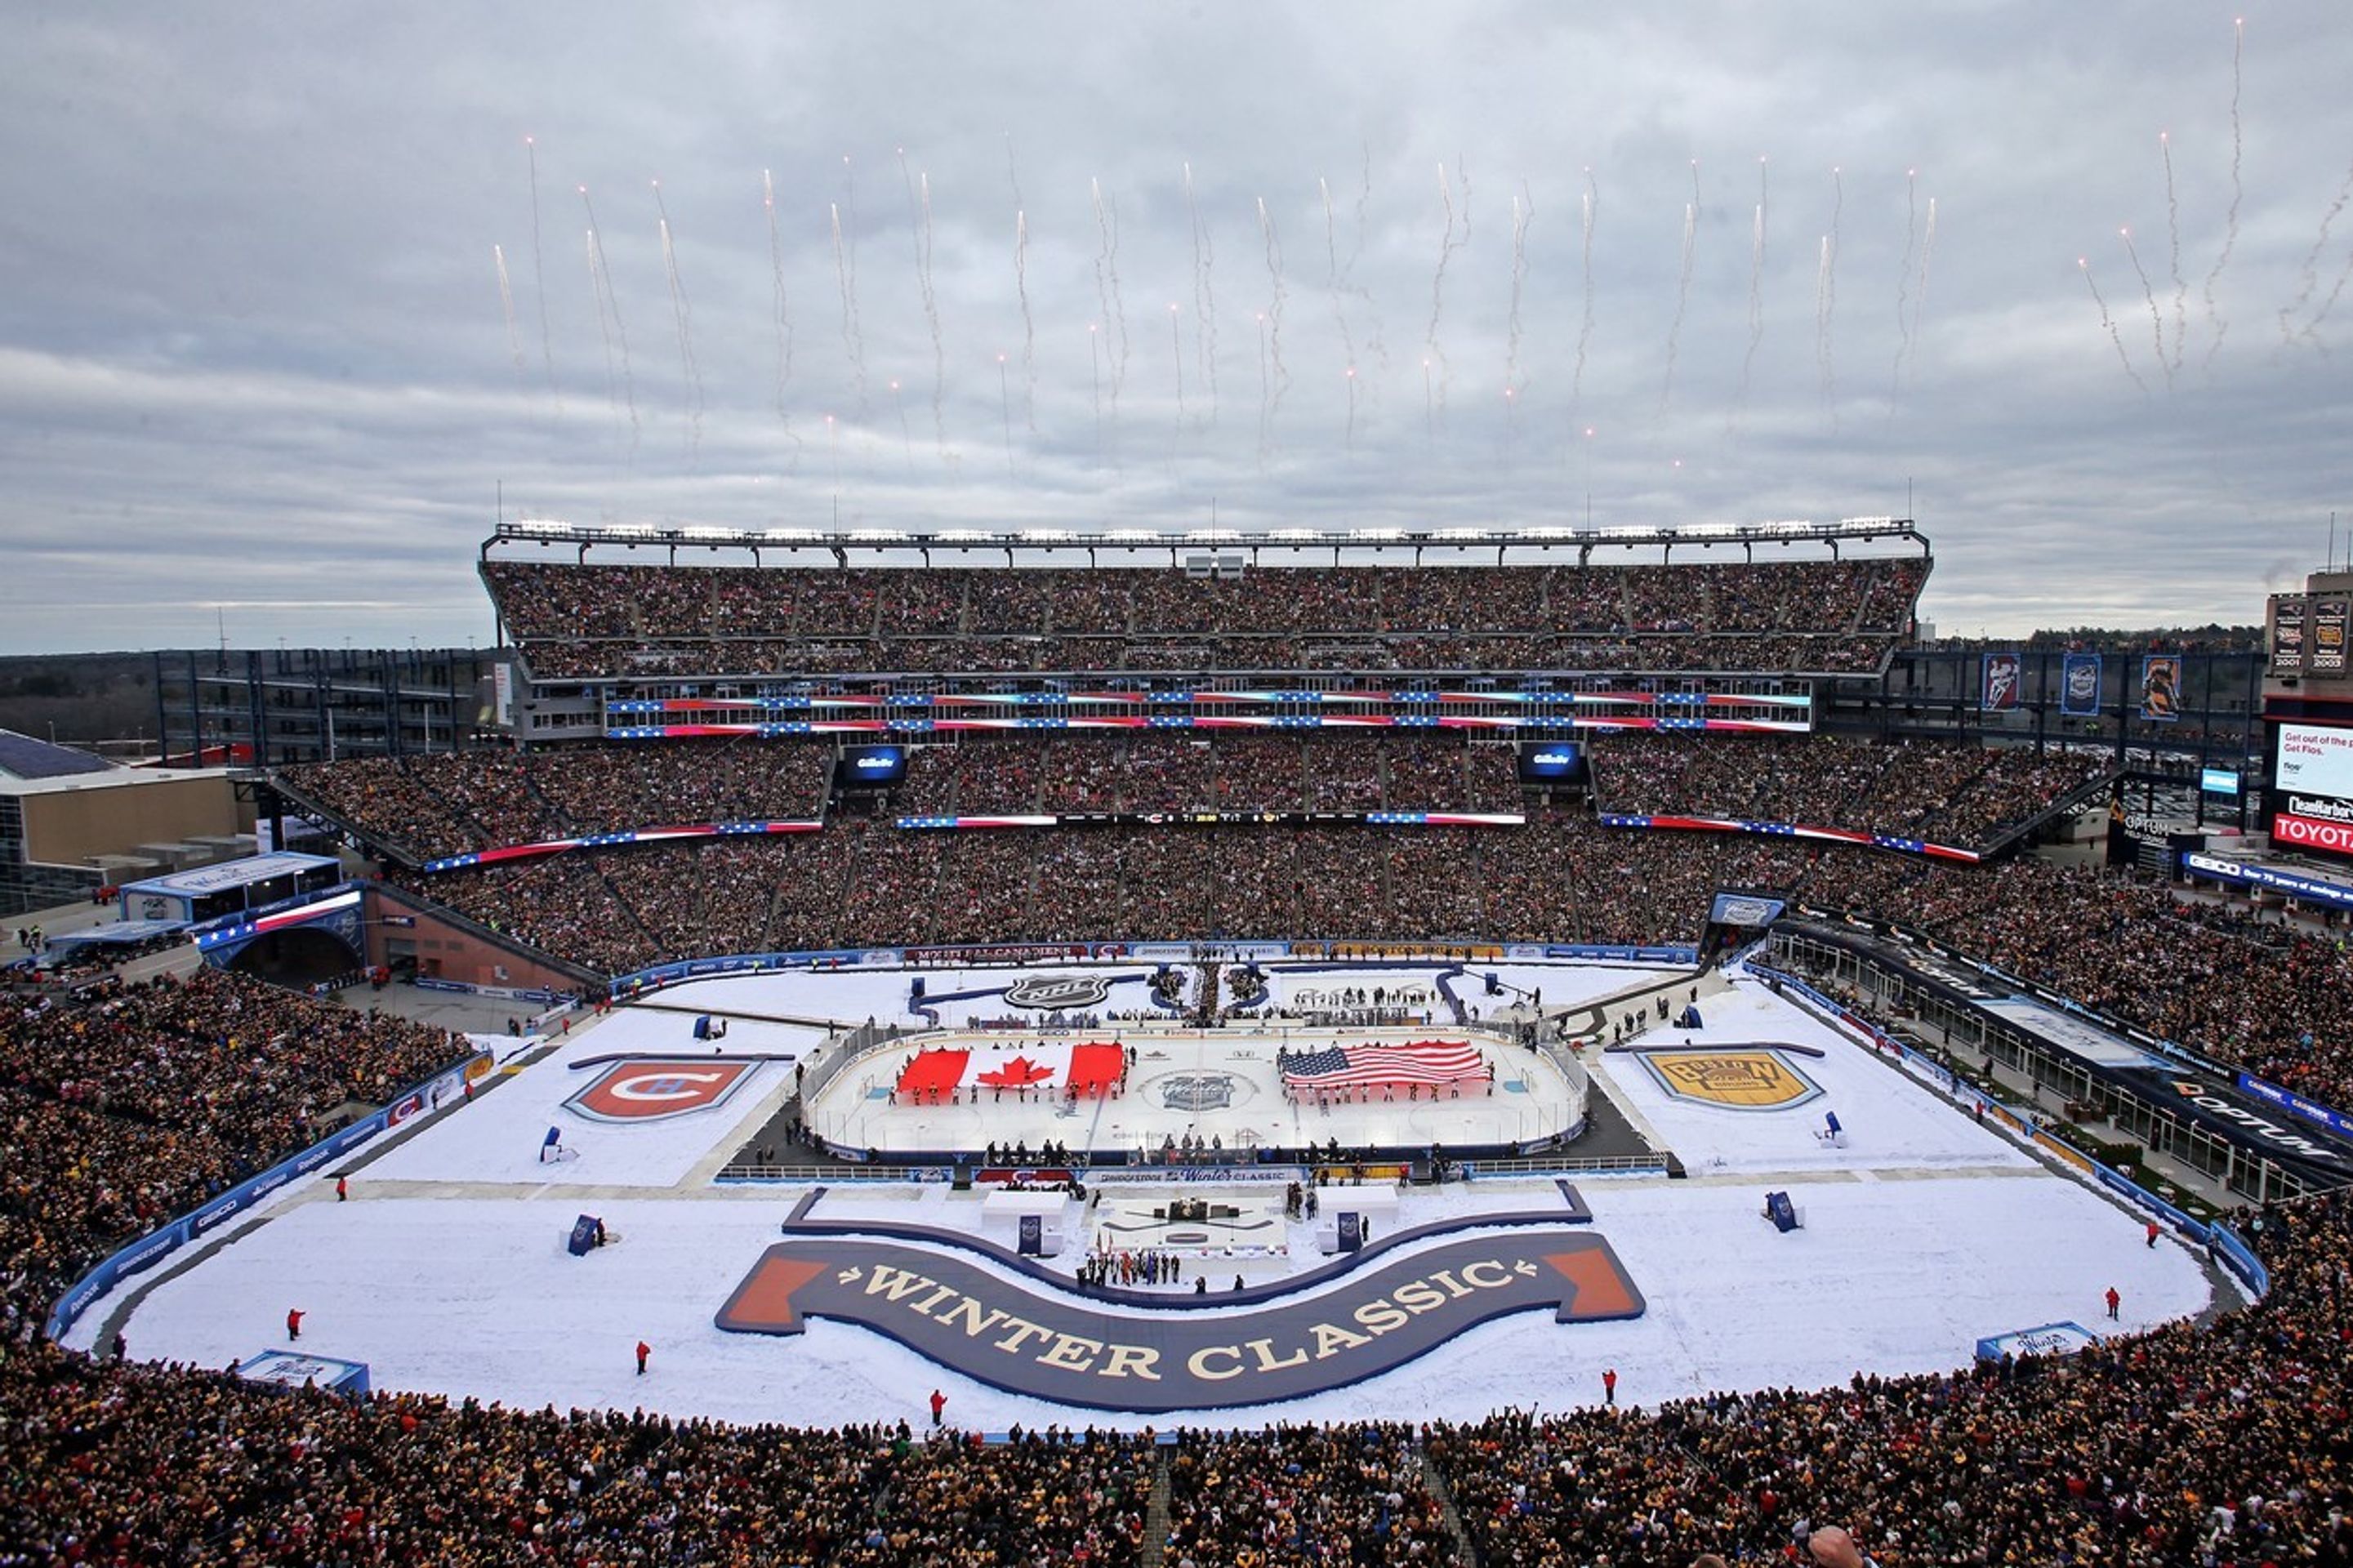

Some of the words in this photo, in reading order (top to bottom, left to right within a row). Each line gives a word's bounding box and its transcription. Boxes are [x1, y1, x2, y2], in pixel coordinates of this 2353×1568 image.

[2284, 744, 2300, 752] Get
[2285, 733, 2301, 742] Get
[2331, 737, 2346, 746] the
[857, 757, 895, 768] Gillette
[1534, 754, 1569, 764] Gillette
[2125, 816, 2169, 836] OPTUM
[2277, 818, 2353, 848] TOYOT
[2190, 854, 2240, 876] GEICO
[1028, 982, 1092, 1000] NHL
[2191, 1097, 2340, 1159] OPTUM
[1180, 1169, 1232, 1183] Winter
[1233, 1172, 1286, 1181] CLASSIC
[197, 1200, 237, 1227] GEICO
[864, 1264, 1161, 1380] WINTER
[1187, 1258, 1514, 1381] CLASSIC
